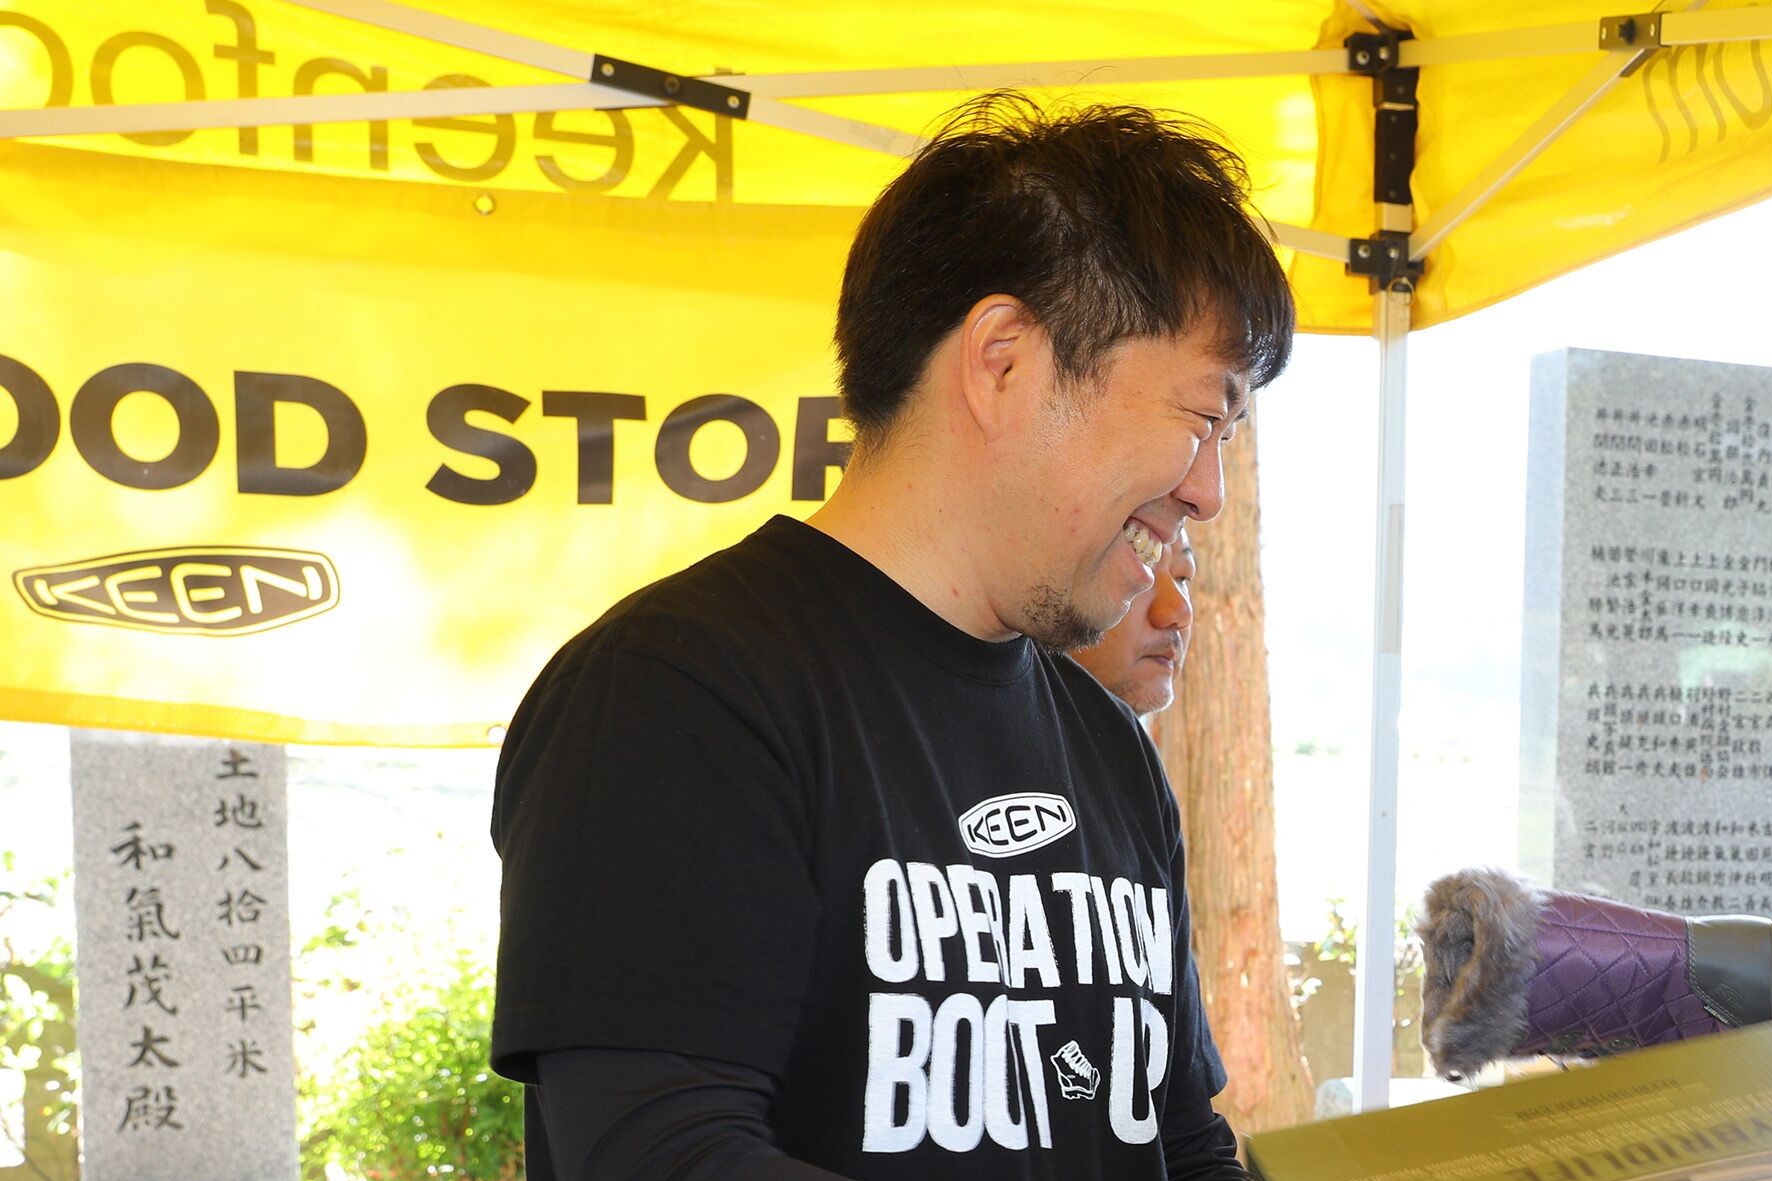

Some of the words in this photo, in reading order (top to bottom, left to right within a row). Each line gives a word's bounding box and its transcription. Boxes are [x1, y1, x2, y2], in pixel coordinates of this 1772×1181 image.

[34, 562, 324, 626] KEEN
[967, 803, 1067, 847] KEEN
[215, 748, 270, 1080] 土地八拾四平米
[864, 858, 1174, 996] OPERATION
[862, 992, 1058, 1153] BOOT
